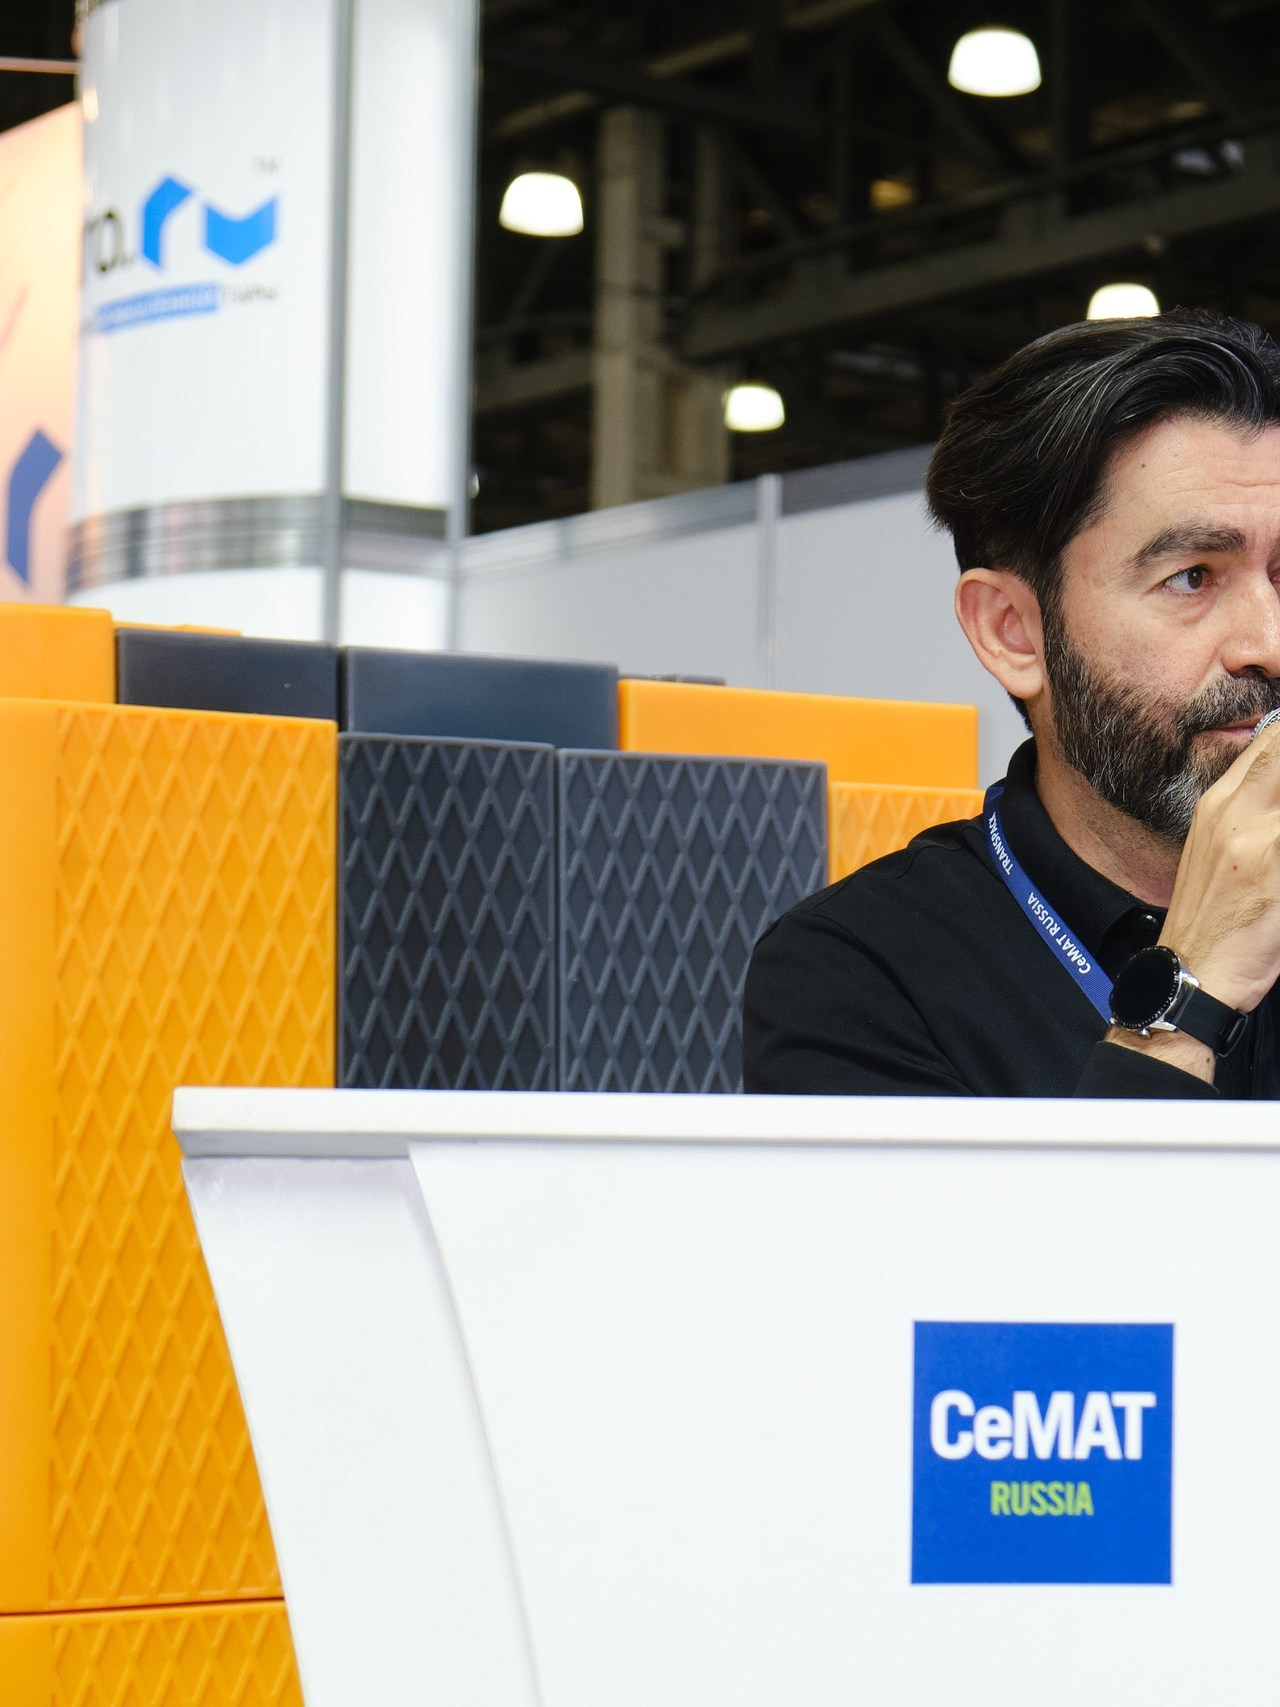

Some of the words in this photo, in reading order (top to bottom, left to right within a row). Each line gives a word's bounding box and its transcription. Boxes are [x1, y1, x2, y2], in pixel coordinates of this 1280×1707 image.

[987, 810, 1015, 876] TRANSPACK
[1026, 891, 1061, 937] RUSSIA
[1055, 933, 1092, 975] CeMAT
[929, 1388, 1158, 1461] CeMAT
[990, 1480, 1095, 1517] RUSSIA
